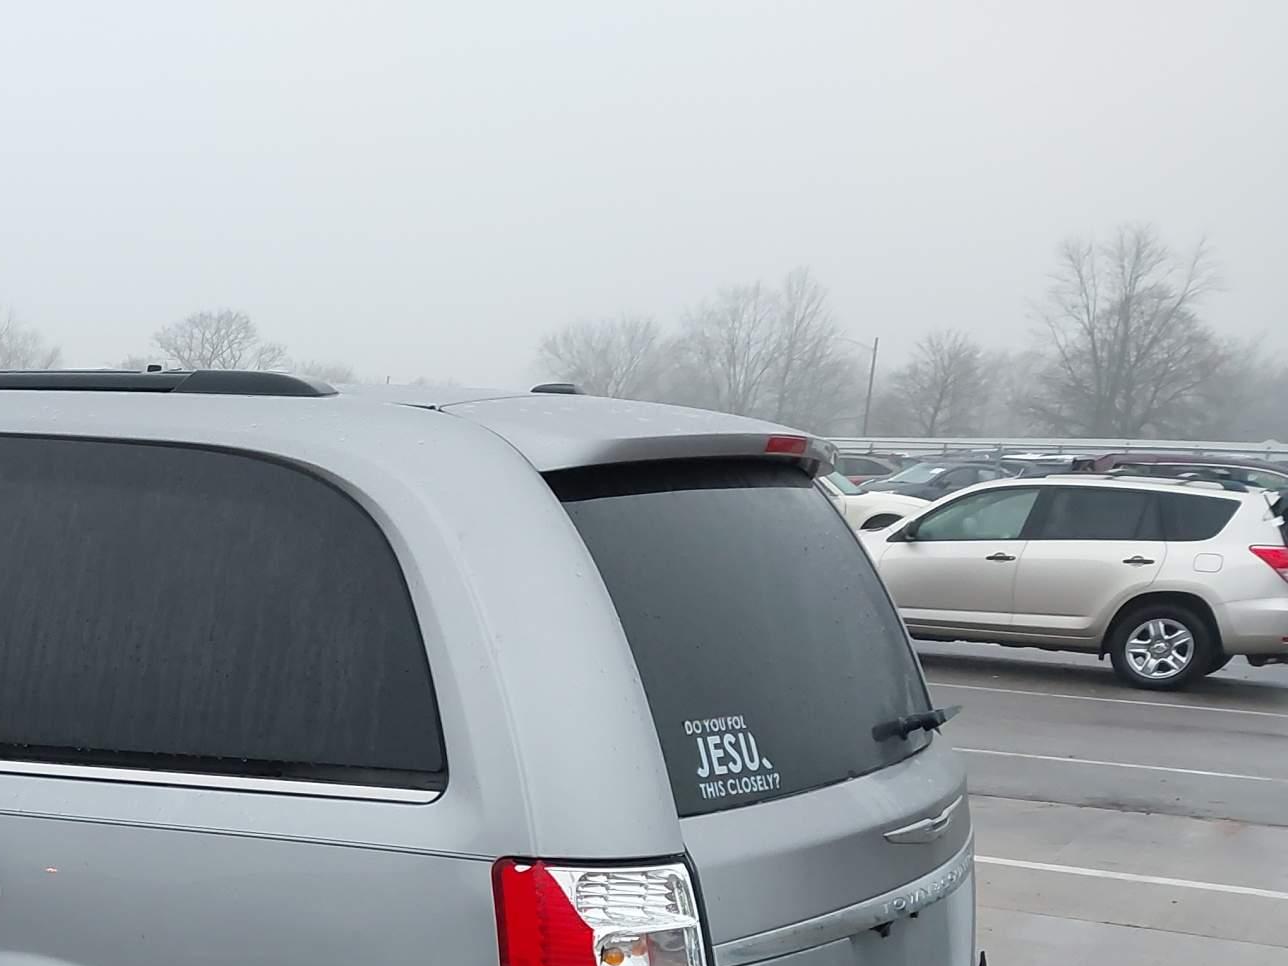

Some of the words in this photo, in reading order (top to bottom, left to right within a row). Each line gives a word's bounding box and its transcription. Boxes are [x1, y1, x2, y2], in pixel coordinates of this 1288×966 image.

[684, 720, 703, 735] DO
[703, 716, 726, 733] YOU
[697, 732, 773, 778] JESU
[699, 782, 726, 799] THIS
[727, 773, 781, 795] CLOSELY?
